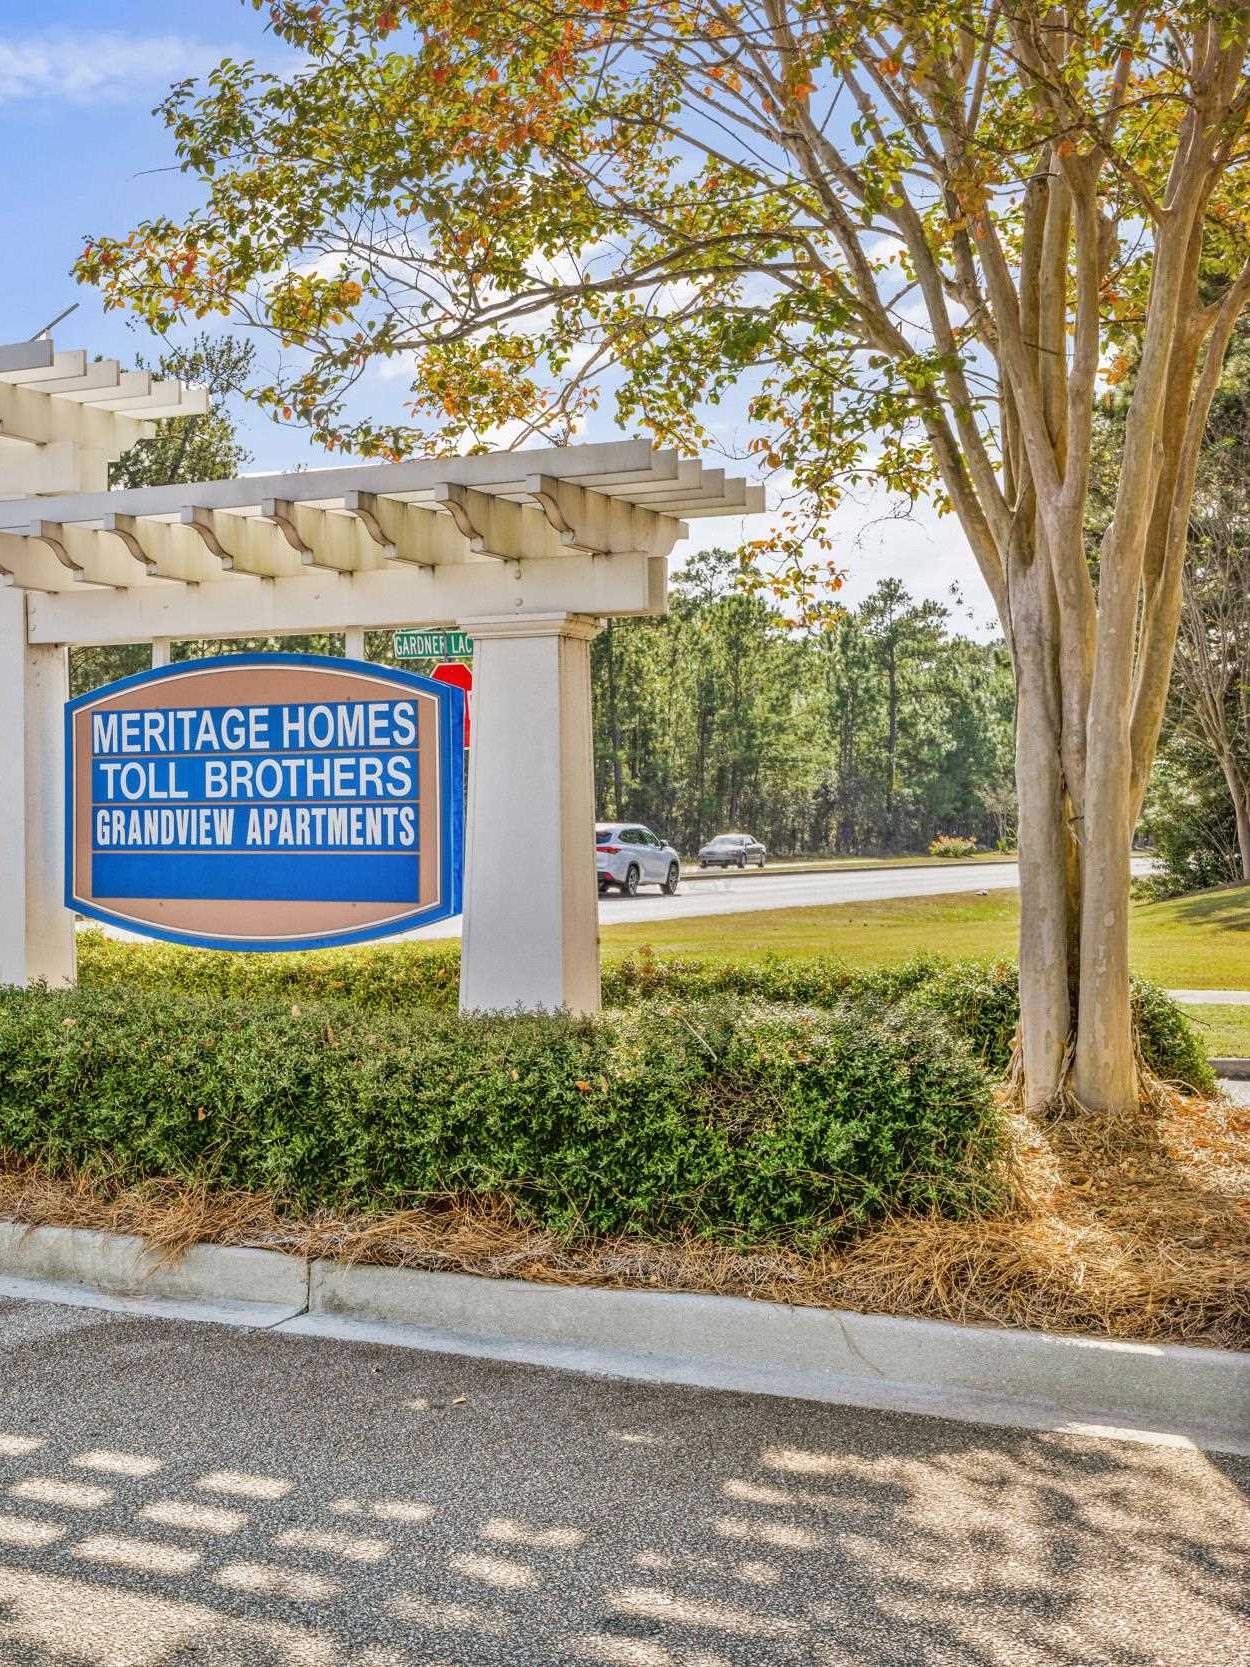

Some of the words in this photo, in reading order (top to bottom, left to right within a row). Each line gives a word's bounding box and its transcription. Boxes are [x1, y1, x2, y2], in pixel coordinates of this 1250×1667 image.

[93, 708, 270, 753] MERITAGE
[282, 701, 416, 749] HOMES
[100, 762, 188, 800] TOLL
[204, 755, 412, 798] BROTHERS
[96, 809, 236, 847] GRANDVIEW
[246, 806, 416, 847] APARTMENTS
